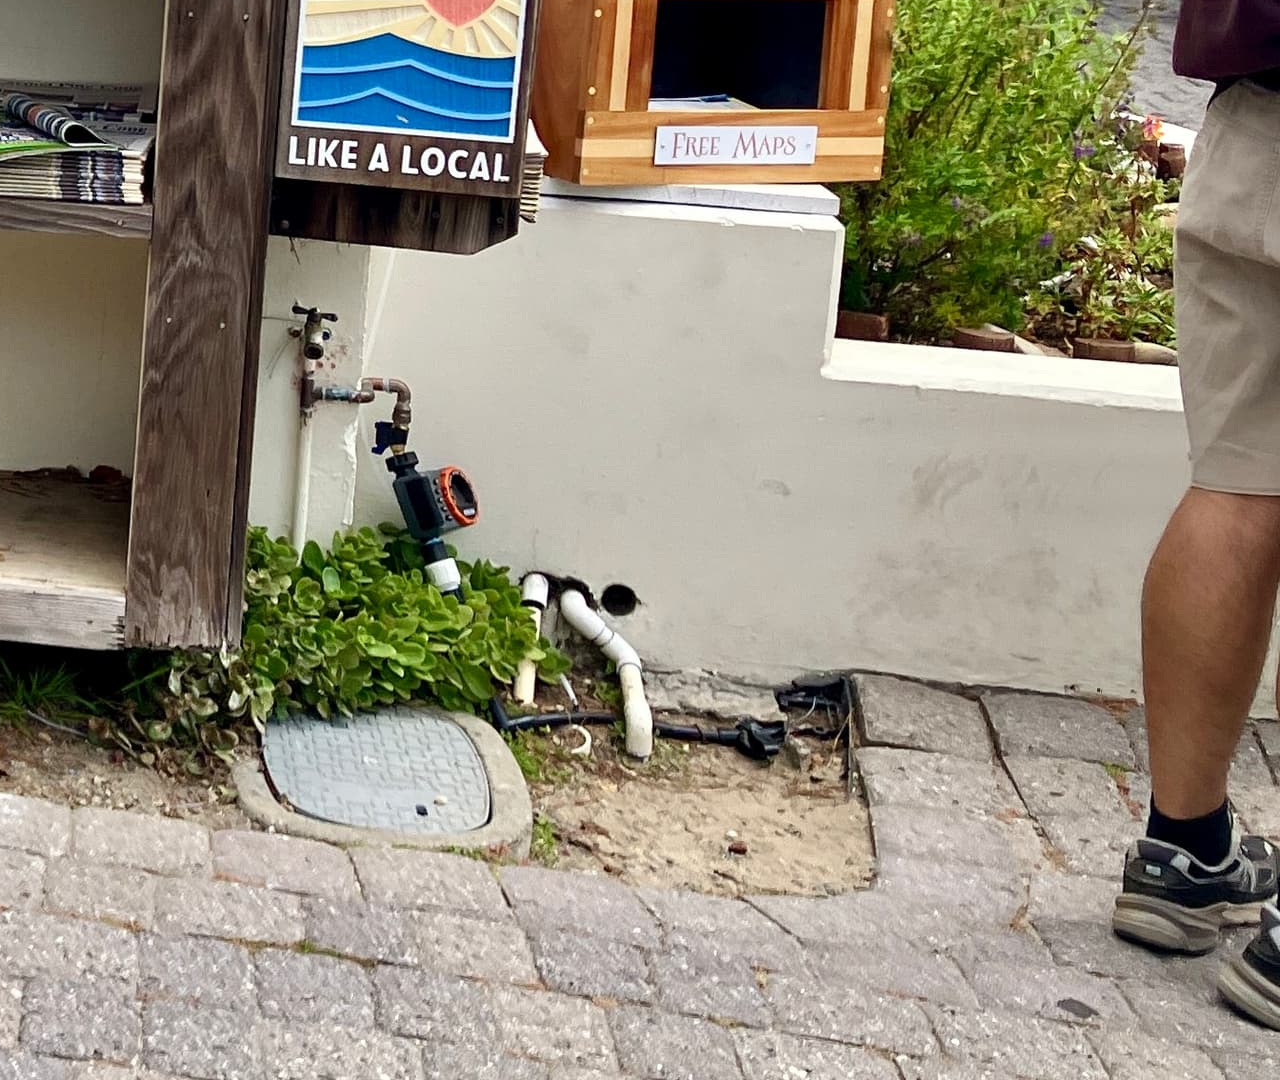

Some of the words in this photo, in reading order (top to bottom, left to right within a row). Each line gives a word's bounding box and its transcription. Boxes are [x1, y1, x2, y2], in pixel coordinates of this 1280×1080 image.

[288, 135, 358, 170] LIKE
[368, 142, 390, 173] A
[401, 144, 511, 183] LOCAL
